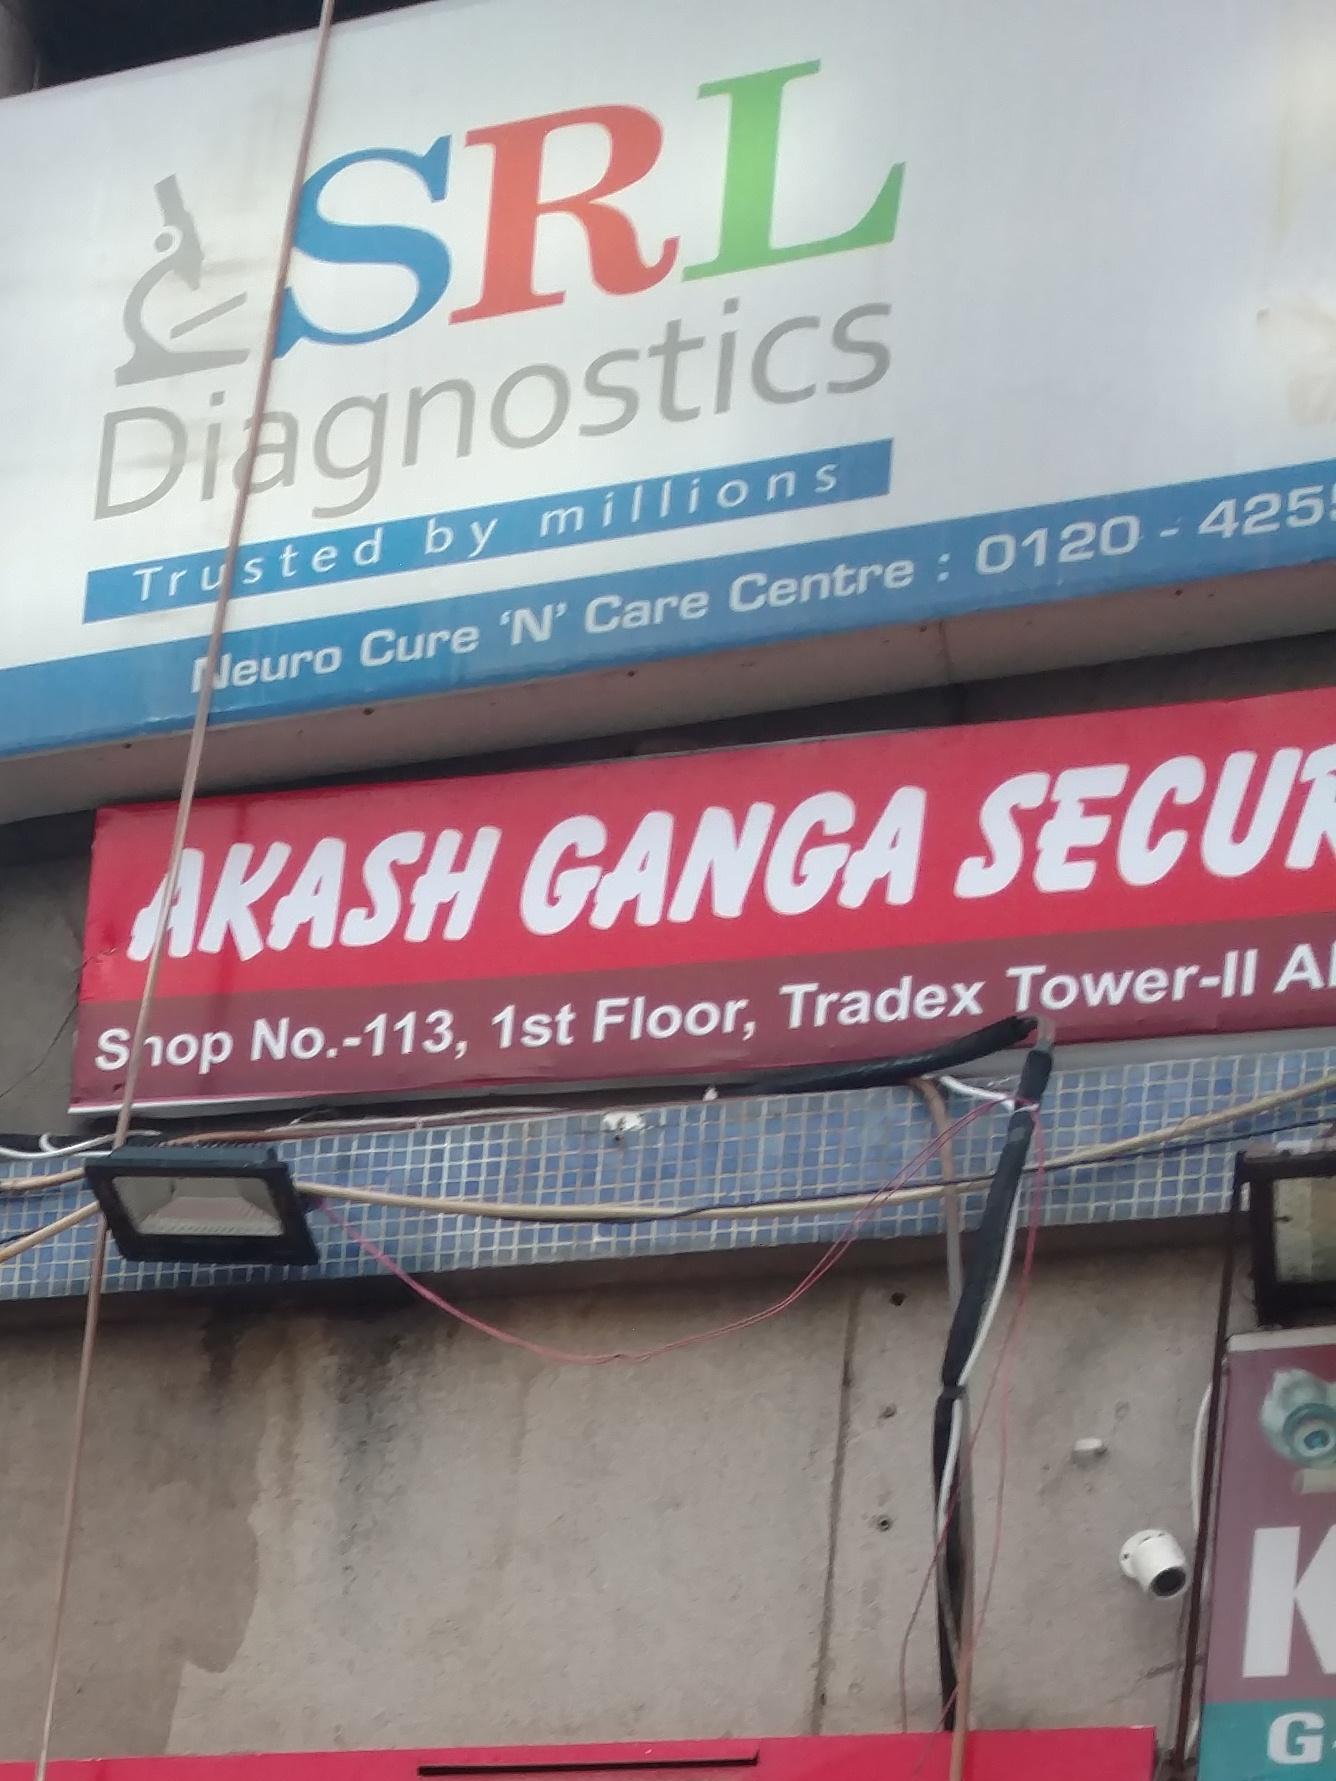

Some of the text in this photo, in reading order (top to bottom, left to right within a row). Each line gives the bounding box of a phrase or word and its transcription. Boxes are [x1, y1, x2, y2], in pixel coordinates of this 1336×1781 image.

[271, 58, 906, 360] SRL
[94, 298, 893, 522] Diagnostics
[133, 460, 842, 601] Trusted by millions
[191, 644, 343, 694] Neuro
[359, 619, 481, 669] Cure
[586, 588, 711, 635] Care
[728, 556, 915, 614] Centre
[974, 513, 1140, 576] 0120
[127, 824, 502, 963] AKASH
[518, 785, 928, 937] GANGA
[250, 1009, 469, 1061] No.-113,
[491, 1002, 576, 1049] 1st
[593, 996, 756, 1044] Floor,
[779, 976, 986, 1031] Tradex
[1006, 949, 1259, 1014] Tower-II
